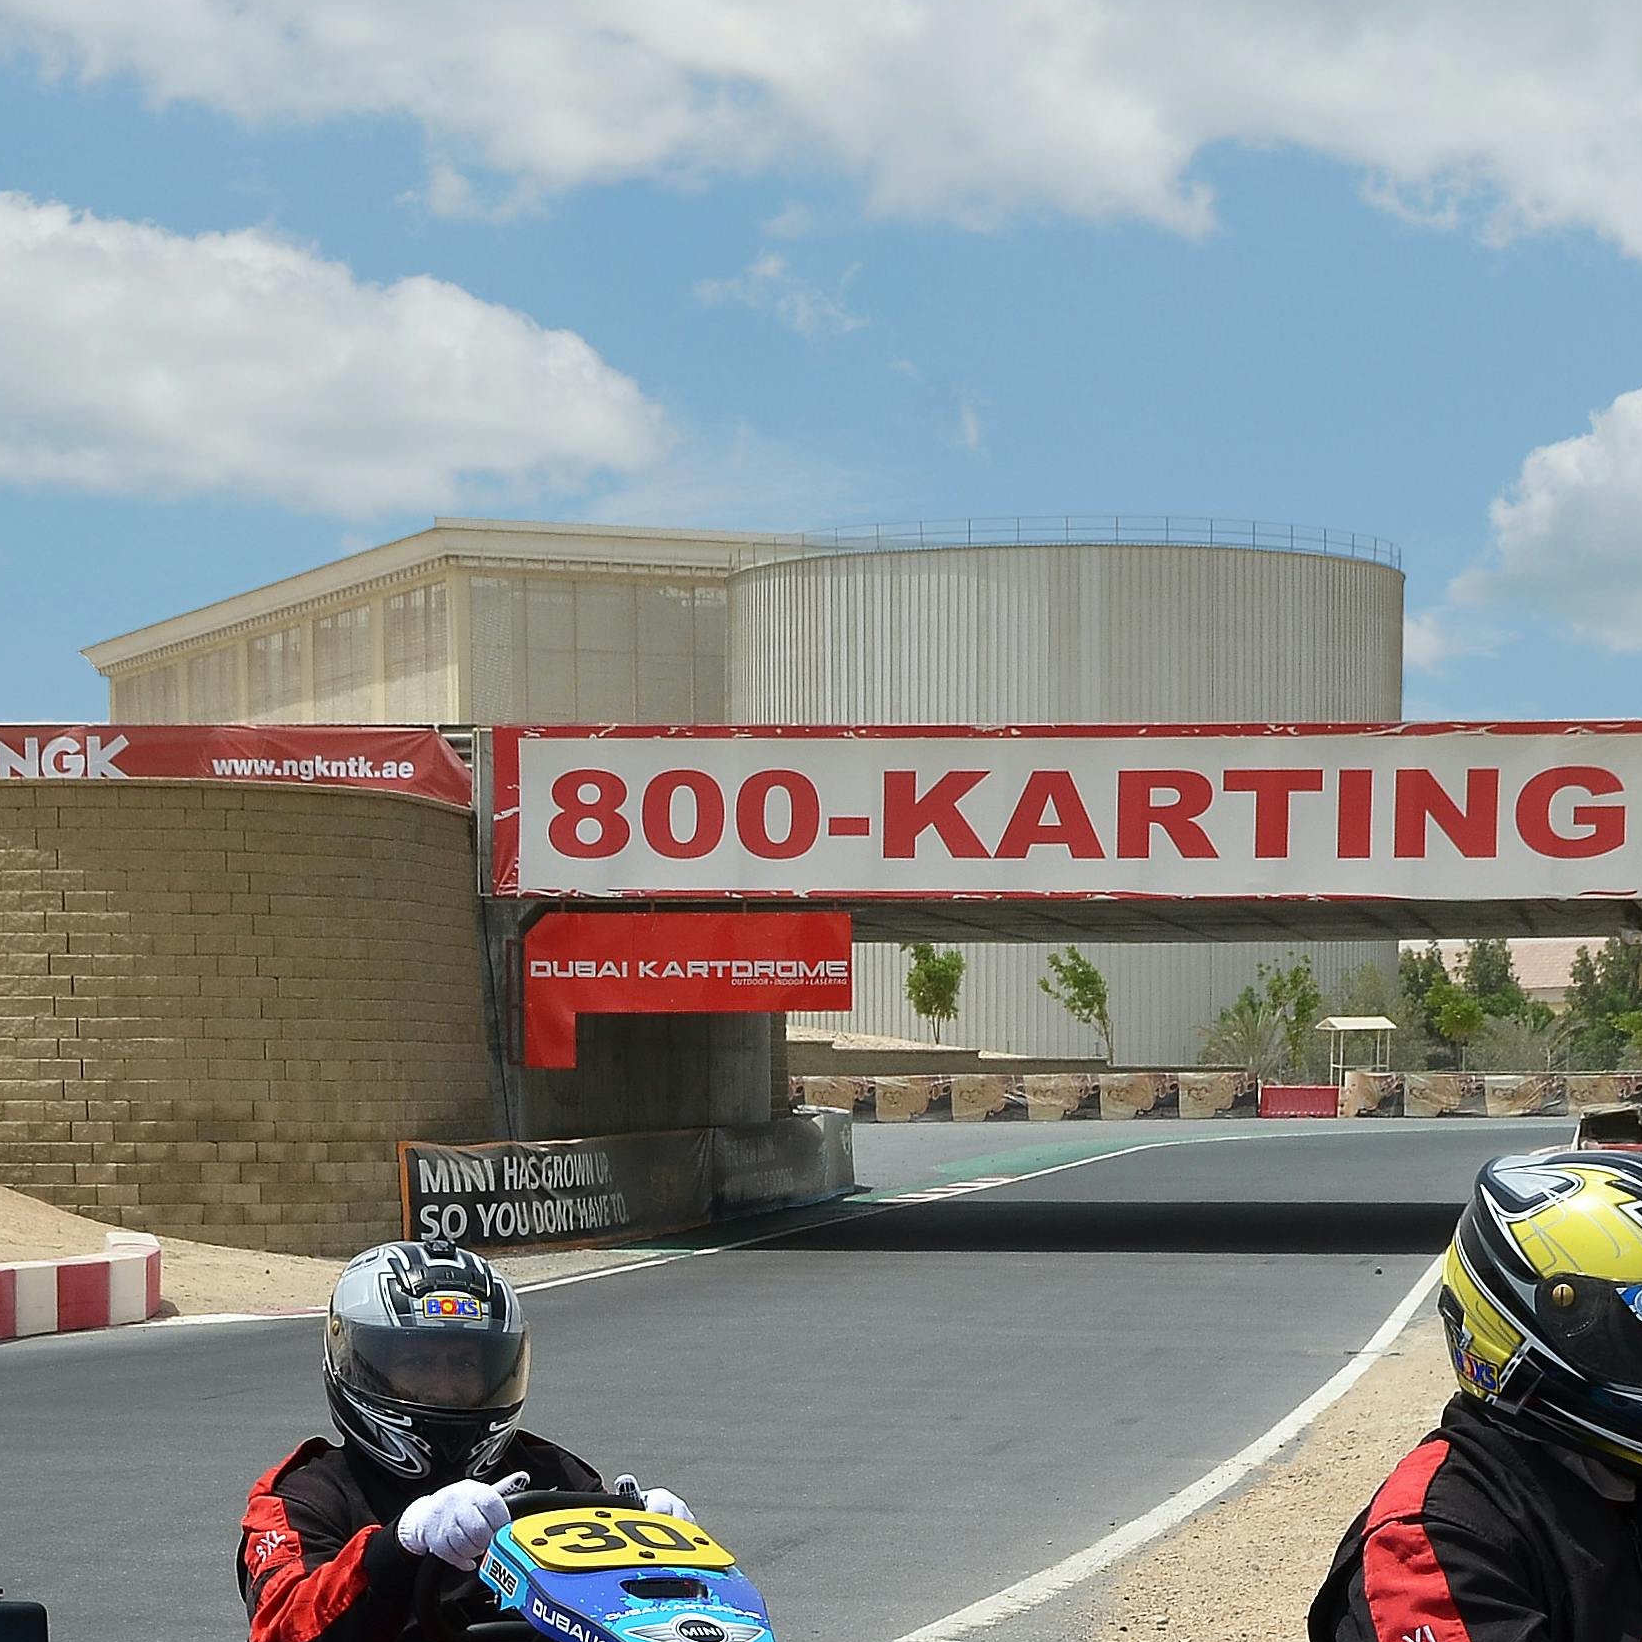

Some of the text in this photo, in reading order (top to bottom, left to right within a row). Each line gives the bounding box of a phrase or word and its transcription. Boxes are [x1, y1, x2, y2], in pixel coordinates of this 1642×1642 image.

[211, 755, 415, 781] www.ngkntk.ae
[547, 764, 1628, 861] 800-KARTING
[530, 960, 848, 978] DUBAI KARTDROME
[731, 978, 769, 986] OUTDOOR
[418, 1158, 495, 1193] MINI
[503, 1156, 540, 1190] HAS
[541, 1154, 594, 1189] GROWN
[420, 1204, 468, 1240] SO
[476, 1201, 529, 1238] YOU
[576, 1195, 610, 1230] HAVE
[610, 1192, 630, 1224] TO.
[255, 1530, 287, 1563] 3XL
[544, 1520, 698, 1553] 30
[488, 1560, 518, 1597] SWS
[606, 1609, 653, 1621] DUBAI
[681, 1626, 724, 1637] MINI
